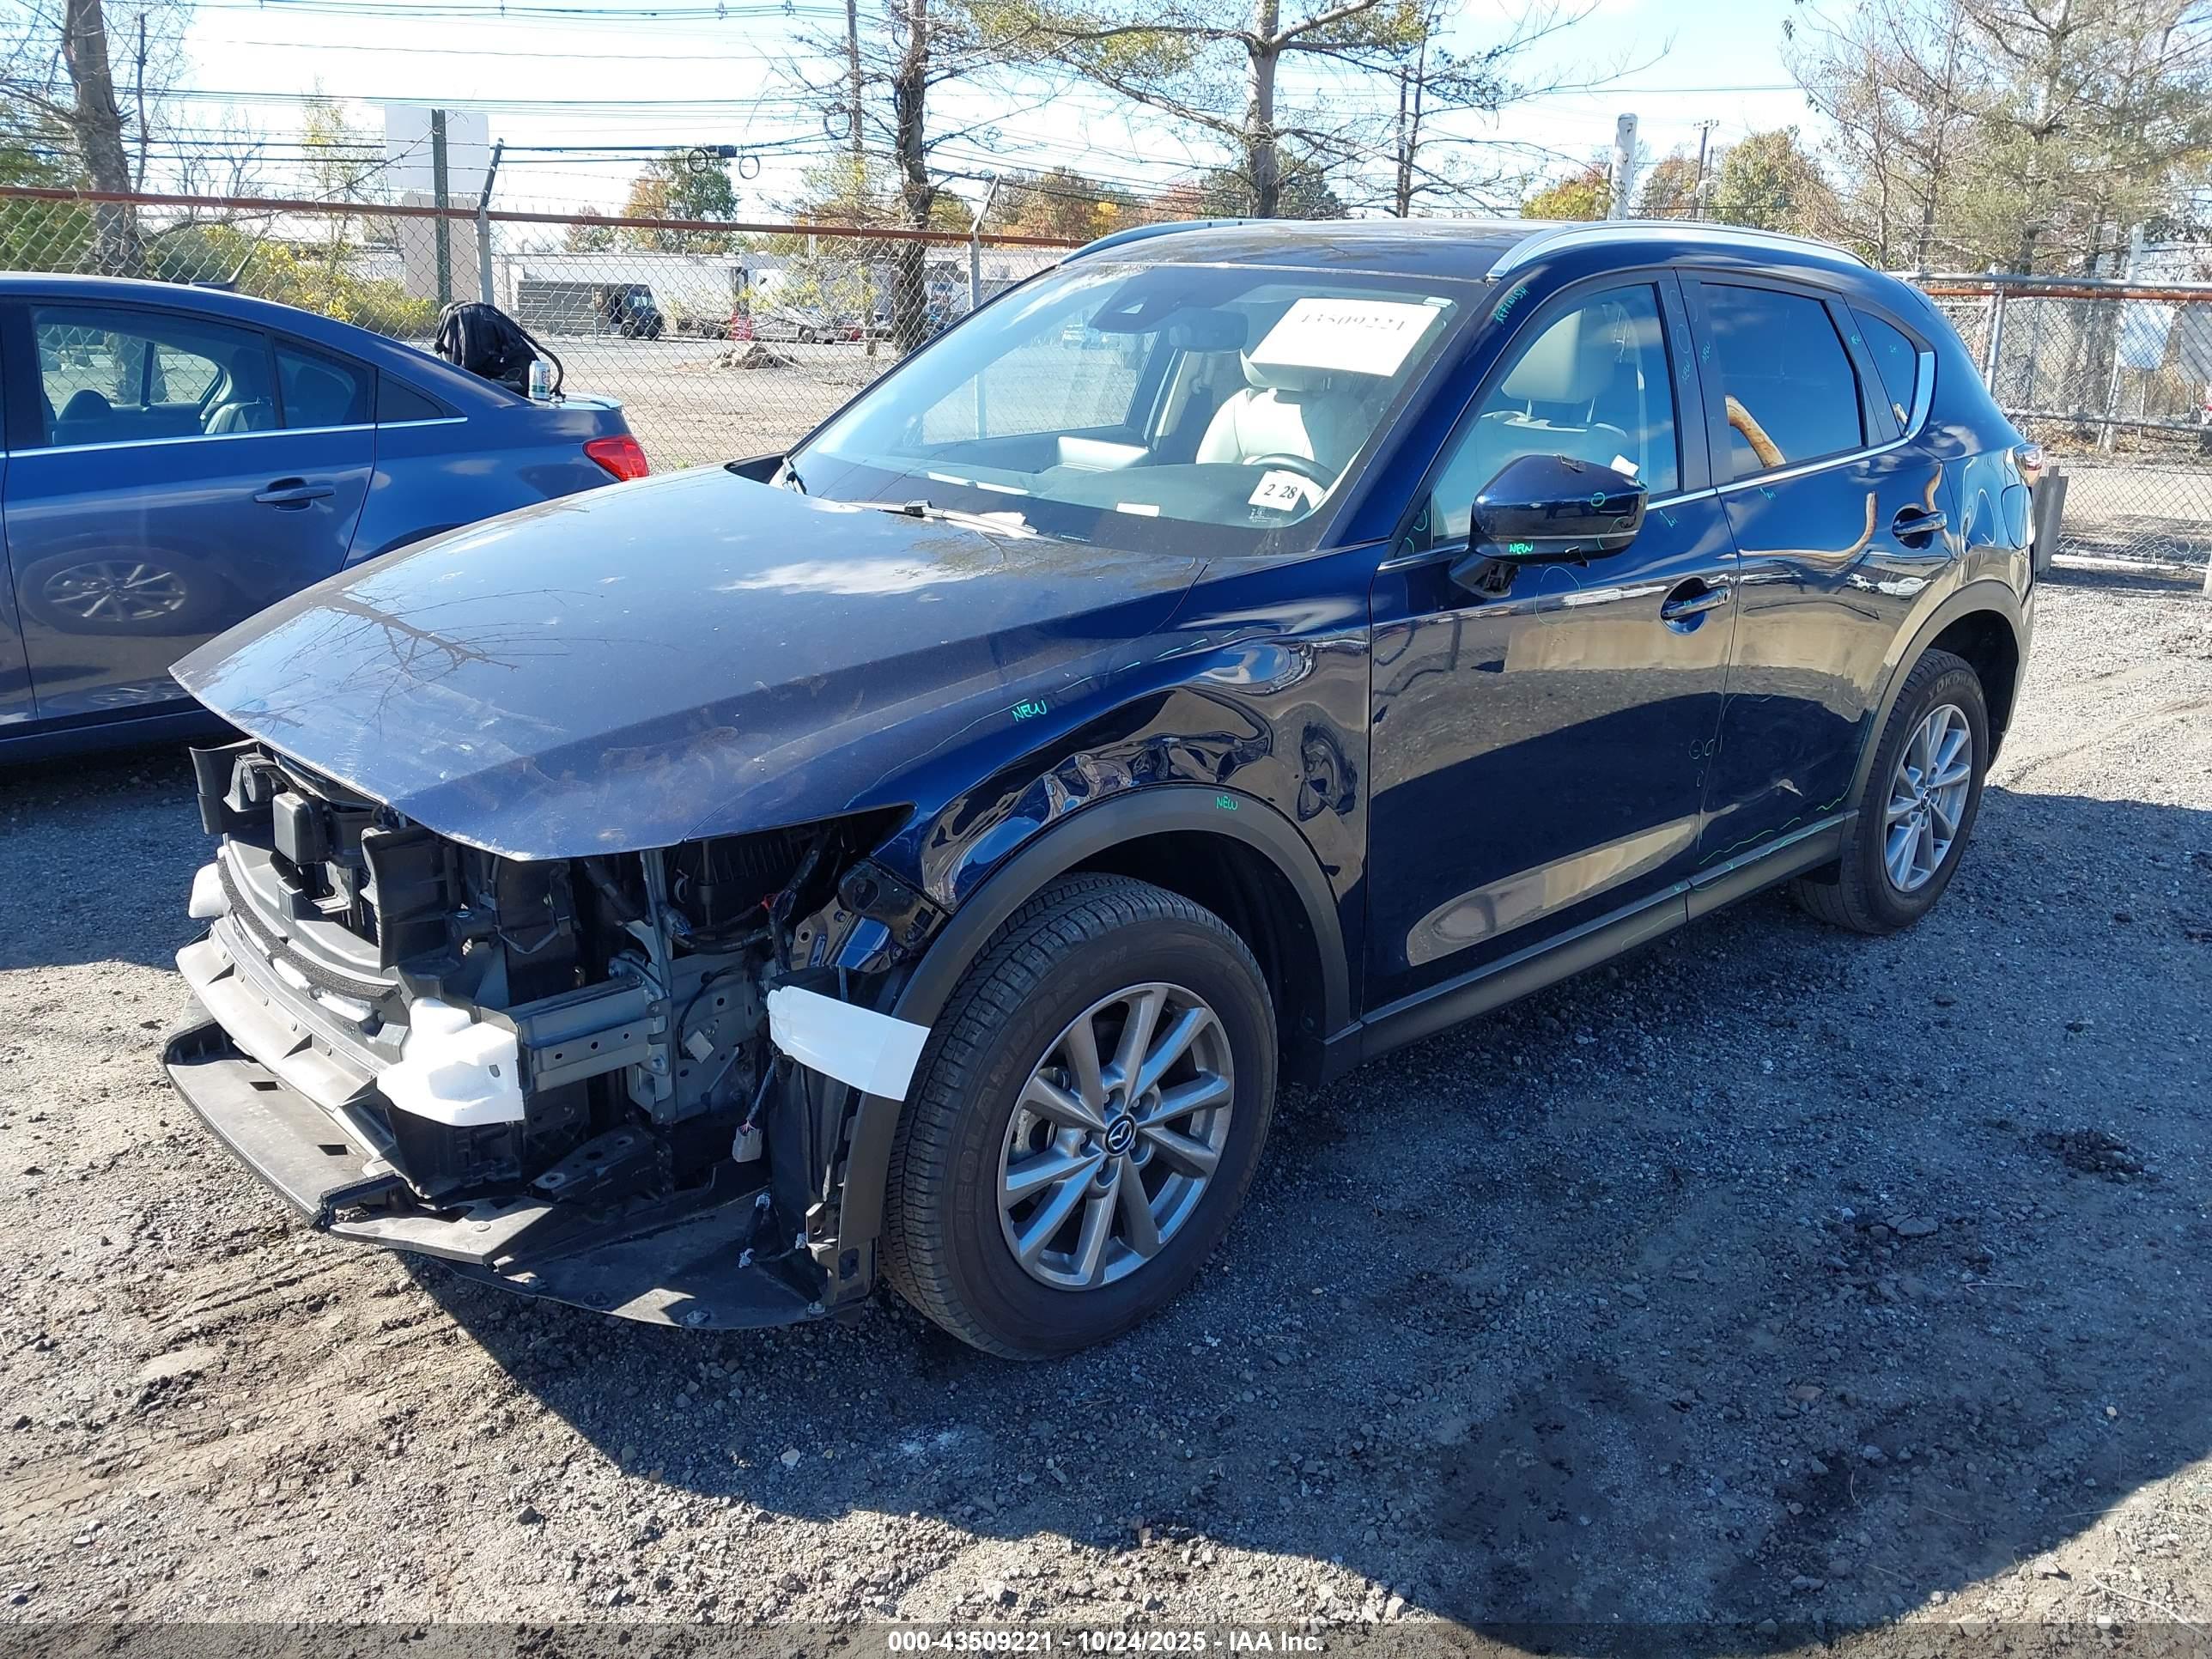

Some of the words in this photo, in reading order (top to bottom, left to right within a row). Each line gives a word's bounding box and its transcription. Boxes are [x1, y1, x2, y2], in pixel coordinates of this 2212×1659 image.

[1263, 483, 1276, 495] 2
[1279, 485, 1297, 499] 28
[1509, 541, 1534, 555] NEW
[1012, 700, 1047, 722] NEW
[1216, 795, 1238, 811] NEW
